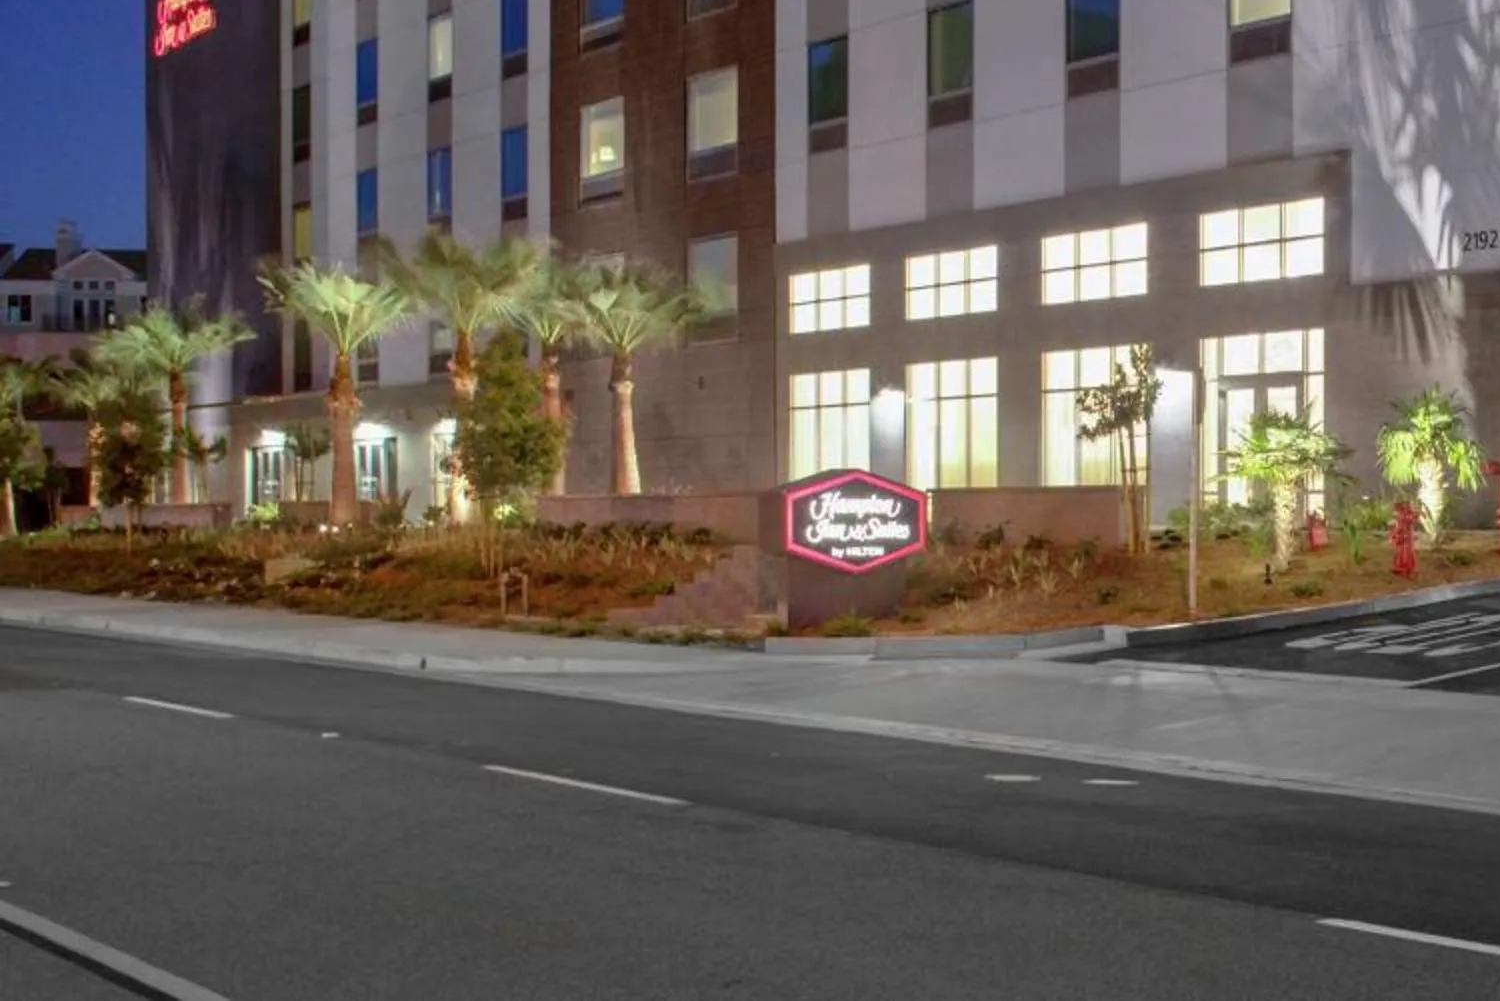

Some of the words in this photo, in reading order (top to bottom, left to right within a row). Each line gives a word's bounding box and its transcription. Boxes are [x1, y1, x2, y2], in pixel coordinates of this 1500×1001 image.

[1463, 230, 1500, 252] 2192
[808, 490, 902, 521] Hampton
[804, 518, 851, 544] Inn
[863, 517, 911, 542] Suites
